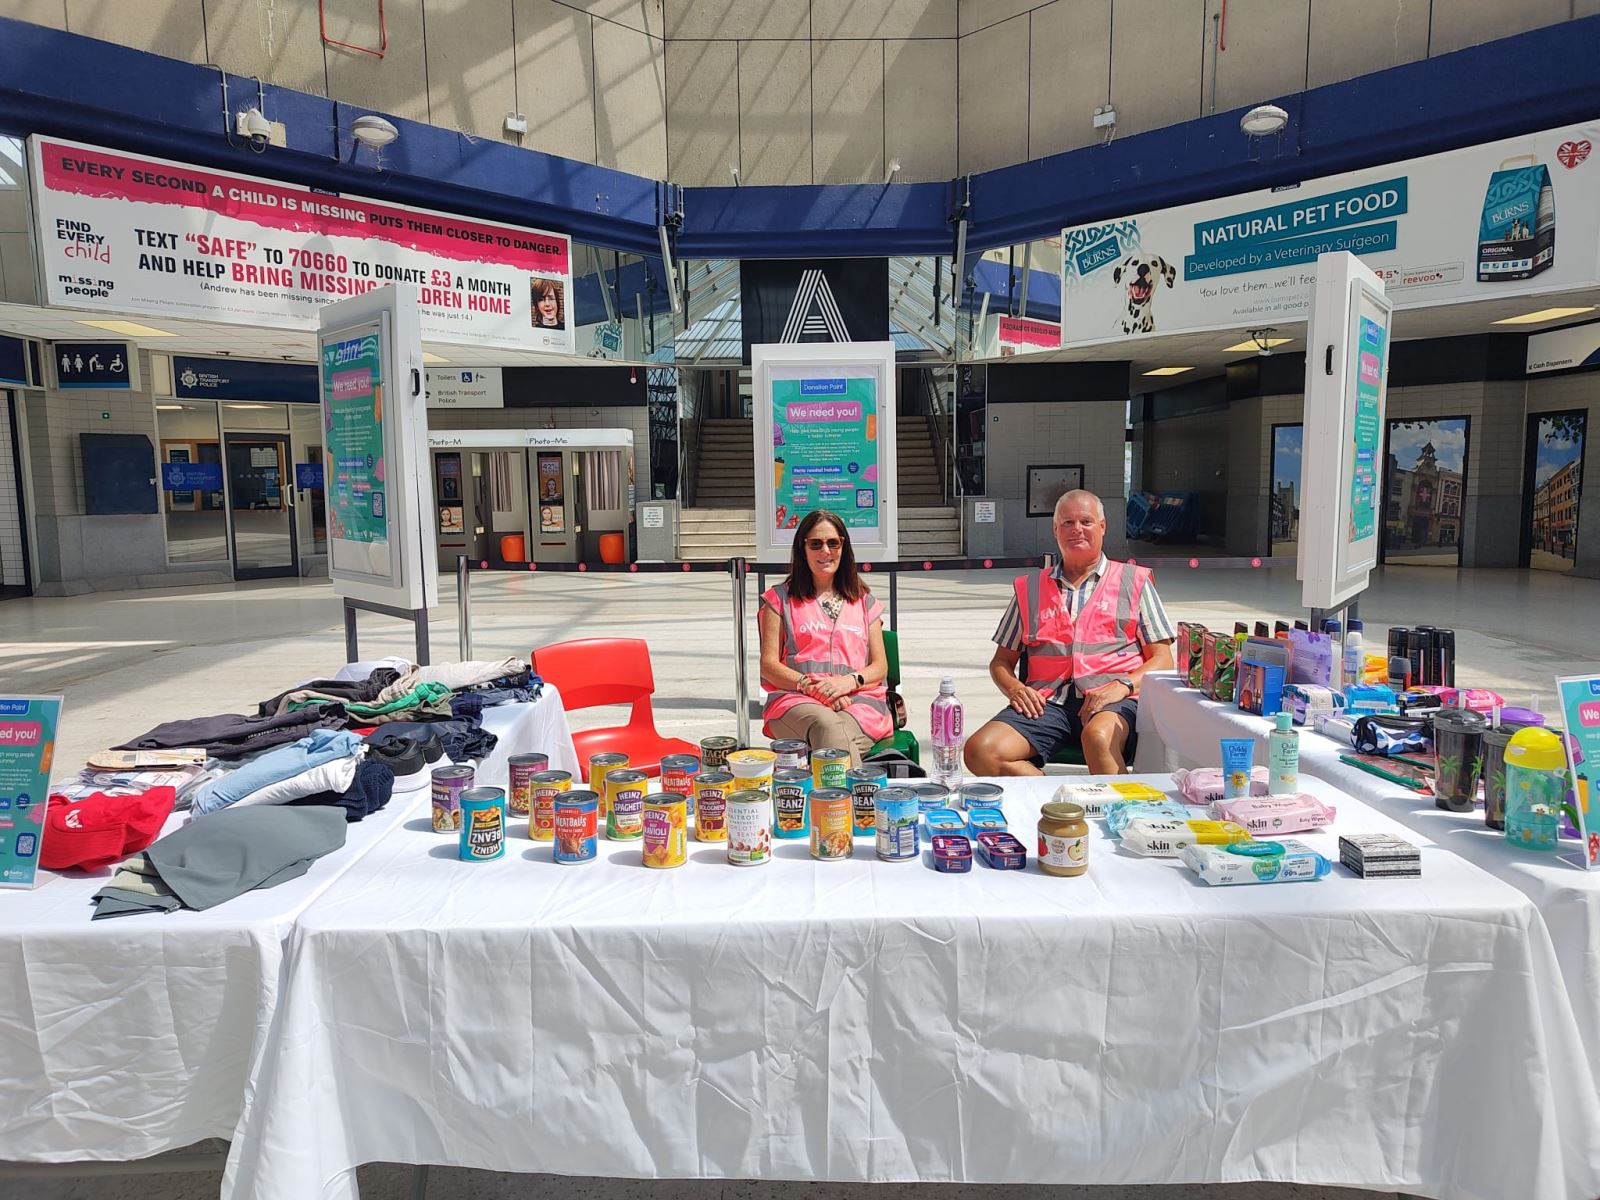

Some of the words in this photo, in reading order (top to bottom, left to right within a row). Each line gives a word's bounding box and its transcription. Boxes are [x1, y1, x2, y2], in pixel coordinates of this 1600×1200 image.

[62, 158, 126, 181] EVERY
[133, 170, 207, 195] SECOND
[212, 185, 225, 198] A
[228, 188, 279, 207] CHILD
[281, 196, 297, 211] IS
[301, 200, 366, 223] MISSING
[370, 213, 403, 230] PUTS
[406, 220, 443, 237] THEM
[446, 227, 494, 245] CLOSER
[496, 235, 511, 248] TO
[513, 240, 562, 256] DANGER.
[1492, 201, 1530, 222] BURNS
[1202, 216, 1288, 246] NATURAL
[1293, 205, 1329, 228] PET
[1335, 189, 1398, 219] FOOD
[57, 218, 91, 233] FIND
[58, 229, 105, 246] EVERY
[65, 240, 111, 265] child
[1081, 244, 1115, 269] BURNS
[1189, 255, 1246, 274] Developed
[1249, 252, 1262, 267] by
[1265, 254, 1271, 263] a
[1273, 241, 1334, 261] Veterinary
[1336, 233, 1389, 252] Surgeon
[1481, 246, 1514, 255] ORIGINAL
[135, 229, 178, 250] TEXT
[264, 247, 283, 266] TO
[288, 247, 348, 274] 70660
[352, 260, 371, 277] TO
[375, 264, 426, 285] DONATE
[431, 270, 451, 288] £3
[456, 276, 465, 290] A
[468, 278, 511, 297] MONTH
[59, 273, 115, 291] missing
[138, 253, 176, 273] AND
[183, 259, 226, 280] HELP
[231, 263, 293, 289] BRING
[468, 293, 511, 316] HOME
[1403, 274, 1435, 285] reevoo
[65, 284, 110, 299] people
[1199, 287, 1218, 299] You
[1220, 284, 1240, 296] love
[1299, 274, 1317, 285] fee
[199, 281, 238, 296] (Andrew
[239, 287, 253, 298] has
[254, 288, 280, 301] been
[281, 292, 313, 306] missing
[315, 296, 336, 306] since
[421, 308, 431, 316] he
[432, 310, 446, 318] was
[1232, 303, 1264, 317] Available
[1283, 300, 1302, 311] good
[1533, 362, 1545, 370] Cash
[803, 383, 829, 392] Donation
[829, 381, 844, 390] Point
[790, 406, 807, 417] We
[810, 405, 834, 417] need
[837, 405, 857, 420] you!
[11, 703, 26, 711] Point
[1582, 708, 1600, 721] We
[15, 727, 37, 742] you!
[703, 749, 730, 760] TAGG
[824, 764, 844, 773] HEINZ
[664, 776, 691, 788] MEATBALLS
[536, 789, 559, 798] HEINZ
[700, 789, 724, 799] HEINZ
[778, 788, 801, 797] HEINZ
[856, 785, 878, 794] HEINZ
[432, 793, 450, 801] RMA
[618, 791, 641, 802] HEINZ
[853, 795, 875, 806] BEAN
[1204, 792, 1224, 802] skin
[615, 801, 642, 813] SPAGHETT
[776, 797, 804, 810] BEANZ
[1084, 804, 1101, 813] kin
[555, 816, 587, 828] MEATBALLS
[1246, 819, 1267, 830] skin
[472, 830, 502, 842] BEANZ
[644, 827, 667, 836] AVIOLI
[475, 844, 500, 855] HEINZ
[1147, 840, 1170, 850] skin
